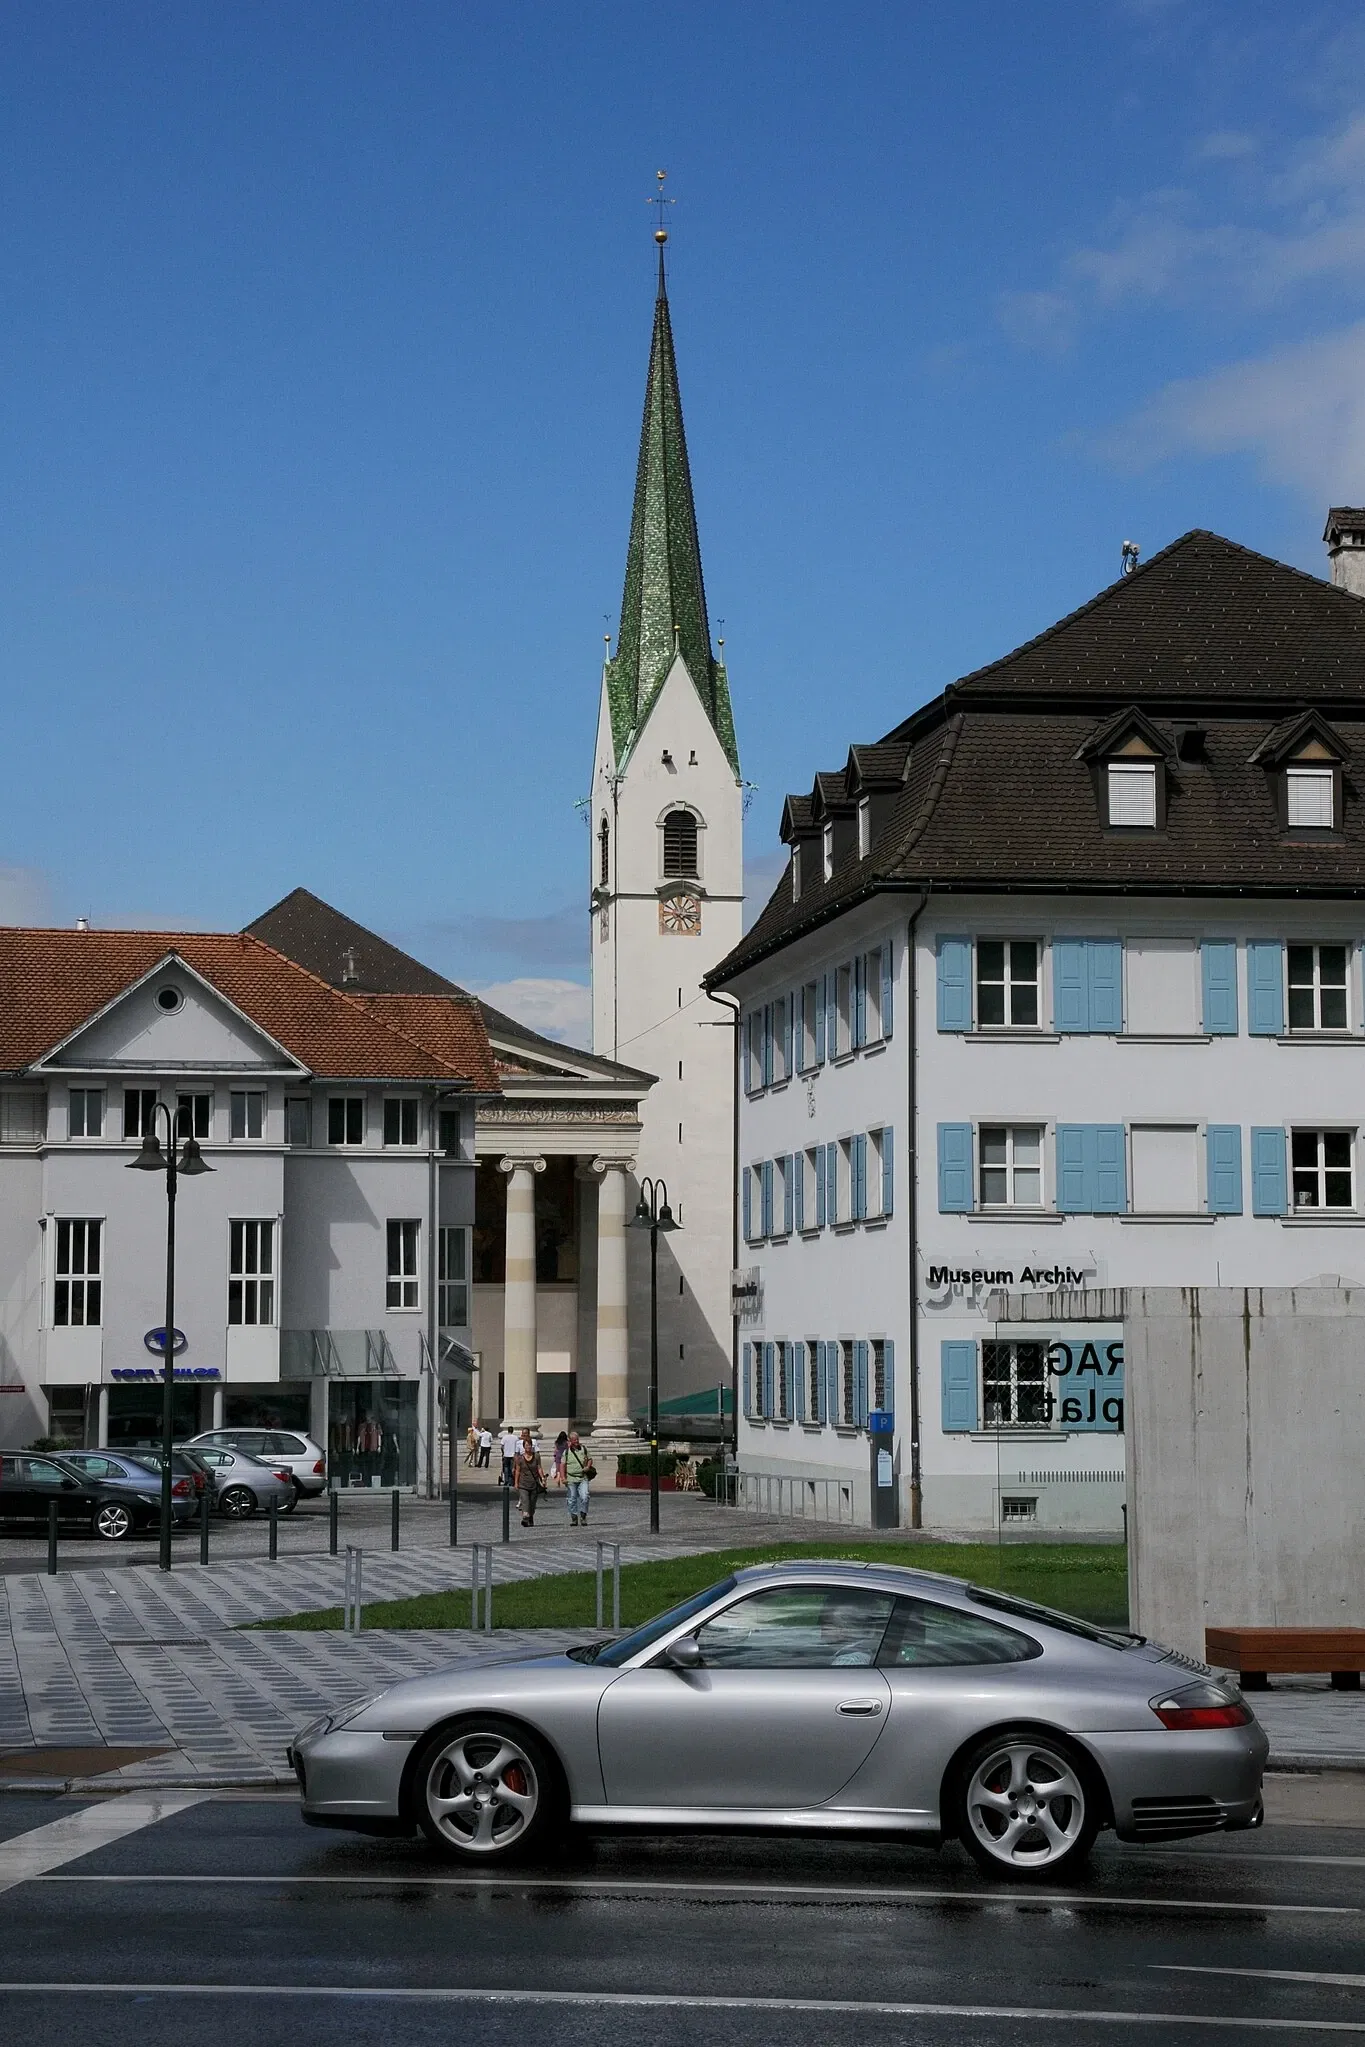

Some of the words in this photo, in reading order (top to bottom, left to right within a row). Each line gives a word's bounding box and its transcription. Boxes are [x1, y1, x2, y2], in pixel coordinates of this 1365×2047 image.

[929, 1266, 1014, 1284] Museum
[1020, 1266, 1083, 1284] Archiv
[880, 1417, 888, 1429] P
